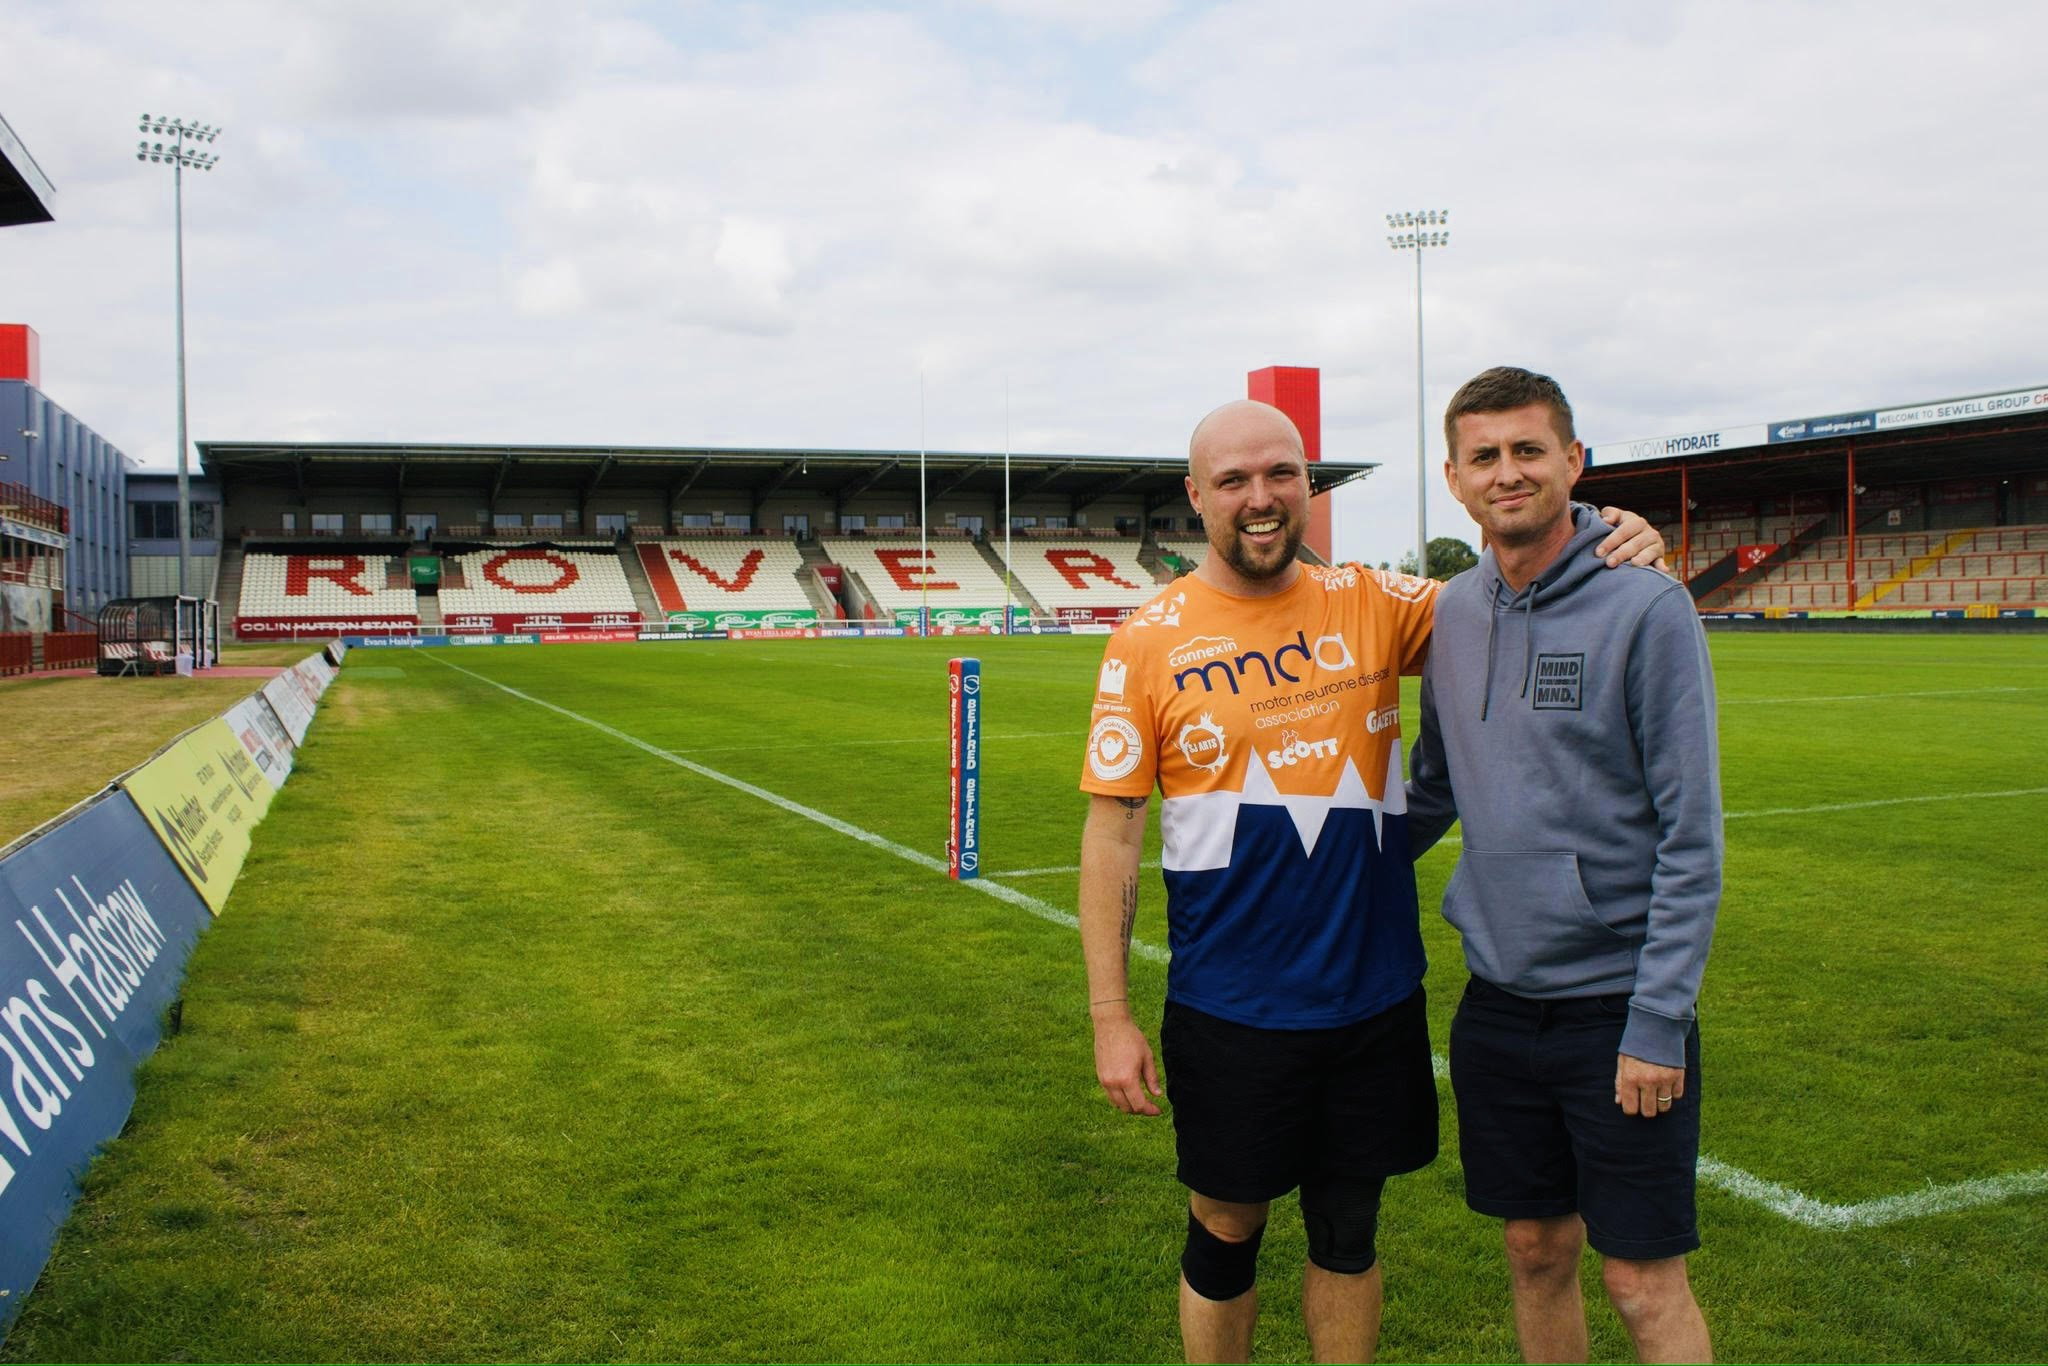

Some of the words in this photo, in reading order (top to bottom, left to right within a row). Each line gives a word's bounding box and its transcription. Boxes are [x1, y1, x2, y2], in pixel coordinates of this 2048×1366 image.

[1880, 411, 1920, 424] WELCOME
[1922, 410, 1933, 418] TO
[1937, 403, 1984, 417] SEWELL
[1987, 396, 2030, 411] GROUP
[241, 623, 291, 632] COLIN
[363, 637, 386, 646] Evans
[821, 628, 860, 636] BETFRED
[865, 628, 903, 636] BETFRED
[1169, 641, 1238, 667] connexin
[1174, 630, 1356, 695] mnda
[1540, 661, 1579, 676] MIND
[1250, 696, 1292, 713] motor
[1295, 678, 1358, 704] neurone
[1537, 688, 1576, 703] MND.
[1255, 700, 1341, 729] association
[966, 698, 977, 770] BETFRED
[1267, 738, 1338, 769] SCOTT
[964, 778, 976, 849] BETFRED
[15, 874, 167, 1040] Halshaw
